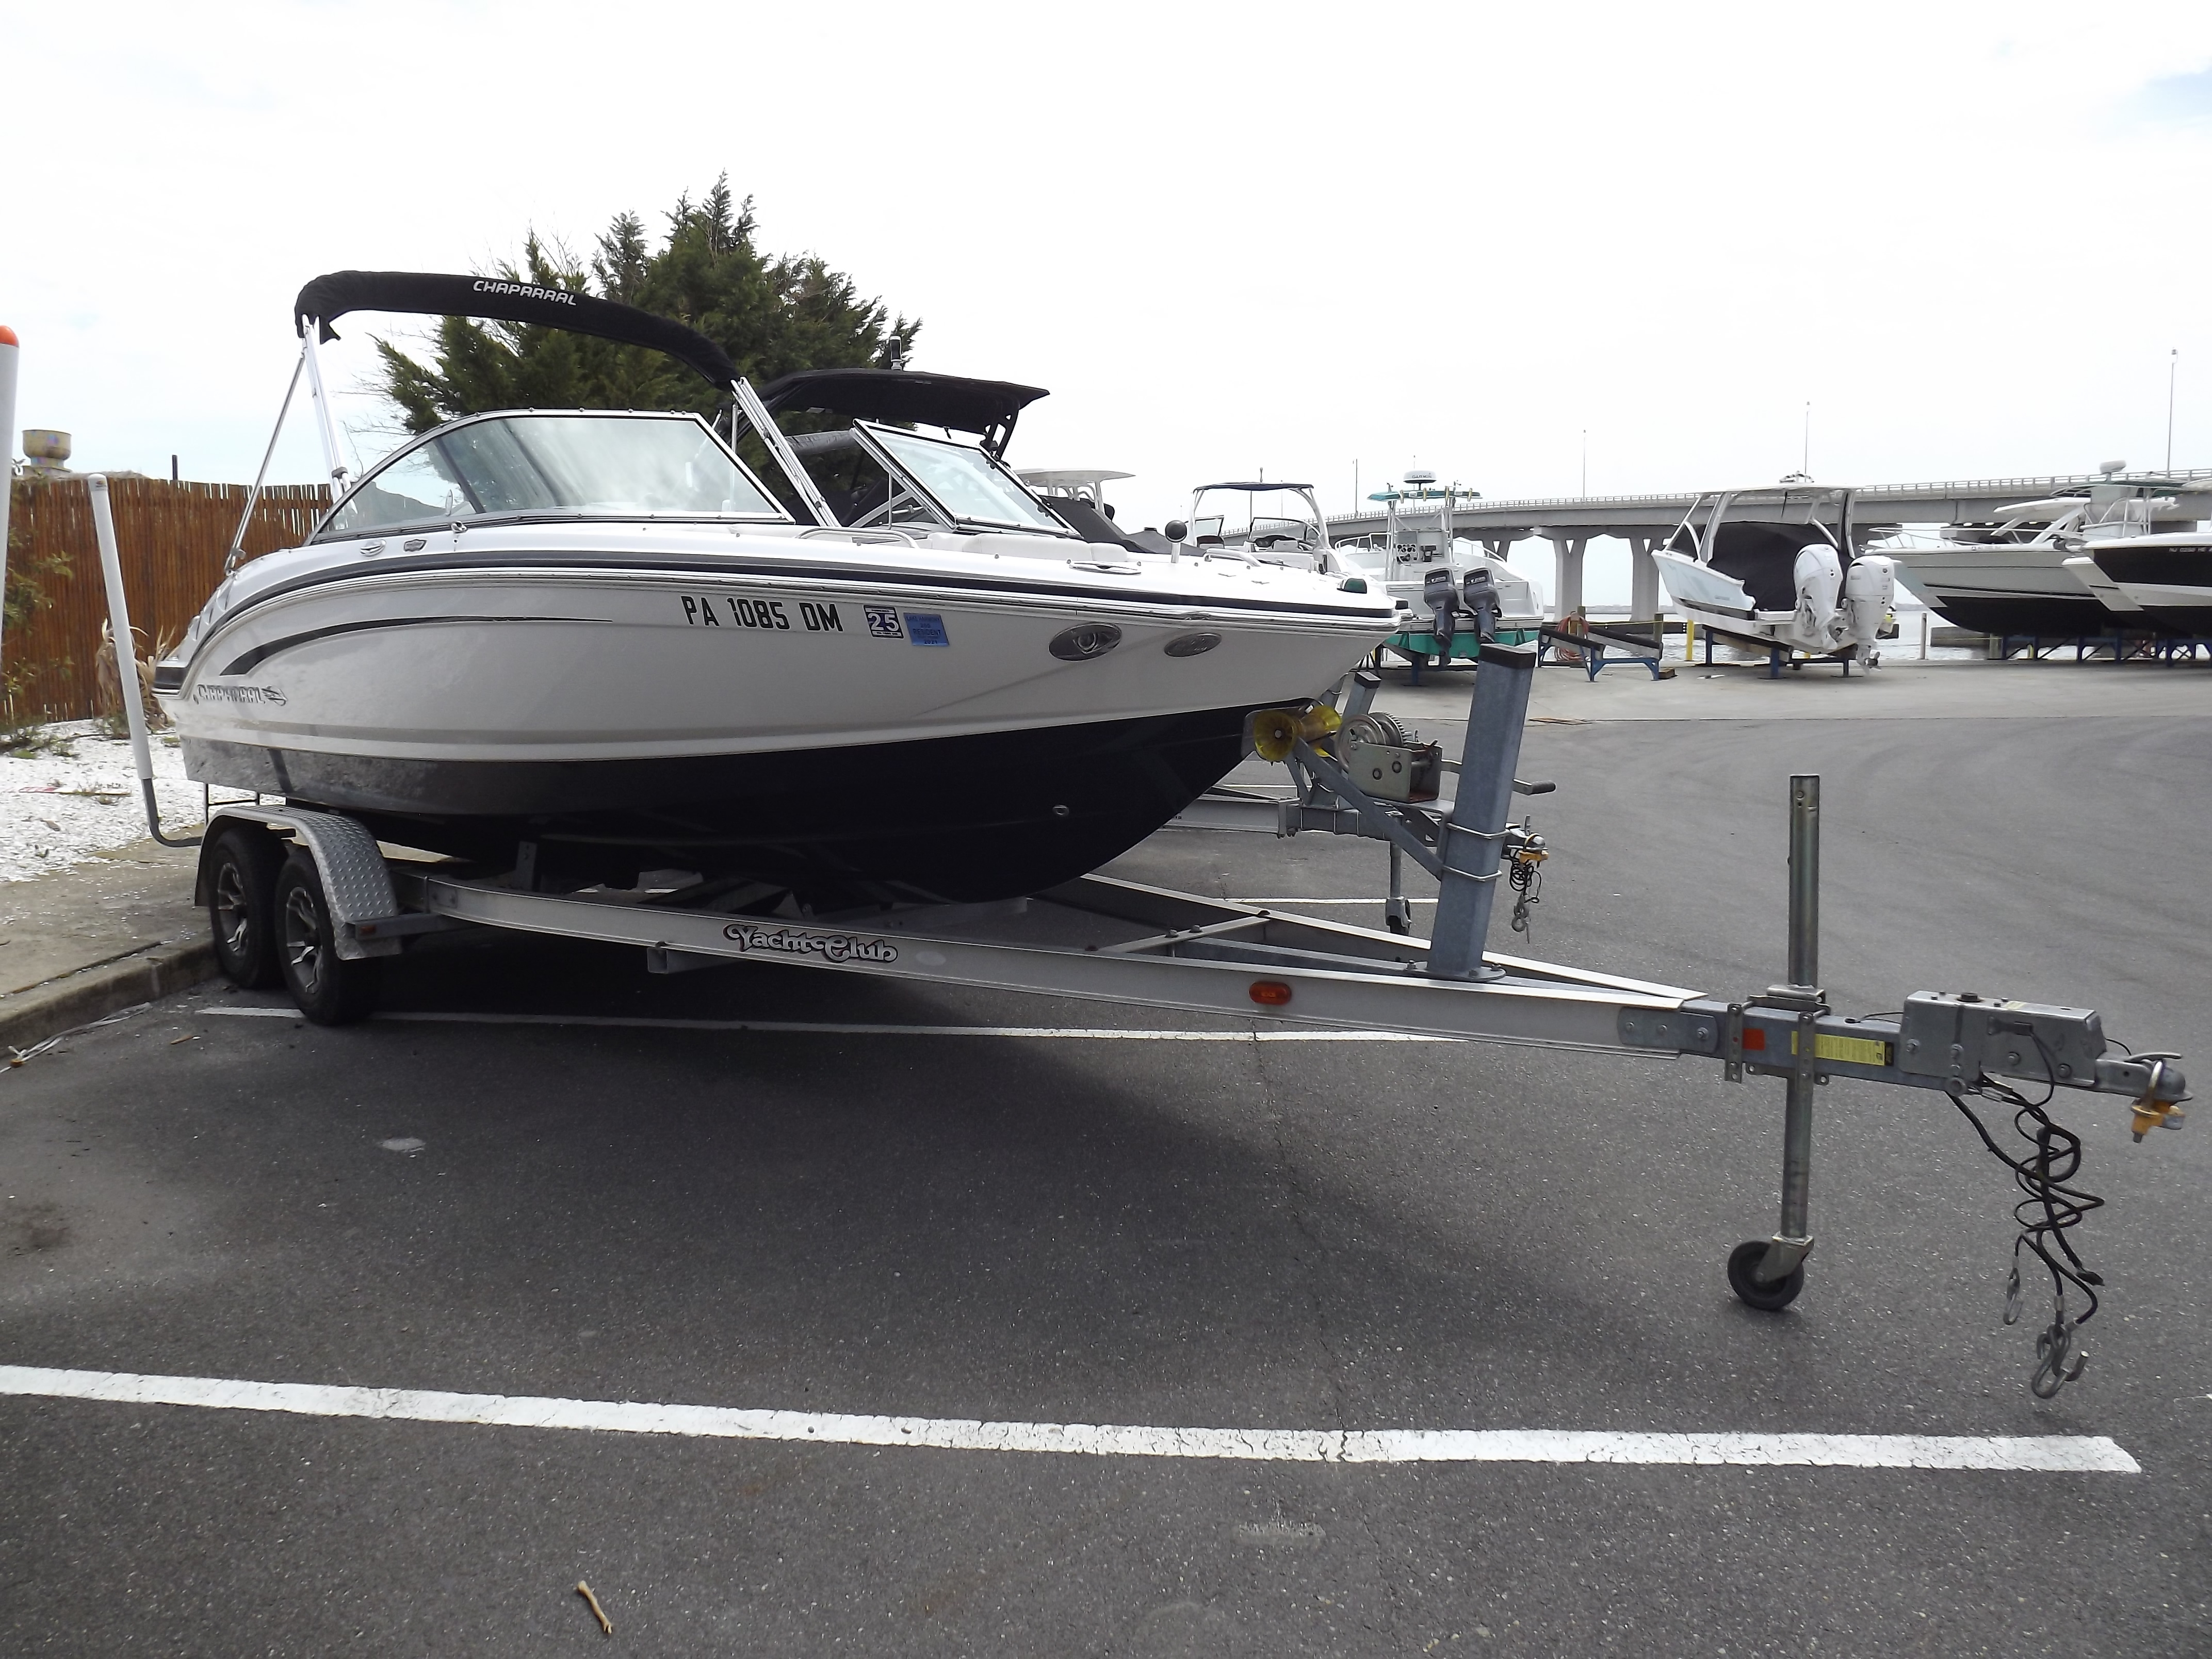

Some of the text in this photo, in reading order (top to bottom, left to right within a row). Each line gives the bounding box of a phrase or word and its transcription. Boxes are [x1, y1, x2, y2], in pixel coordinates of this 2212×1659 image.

[473, 280, 577, 306] CHAPARRAL
[681, 596, 844, 632] PA 1085 DM
[868, 613, 899, 631] 25
